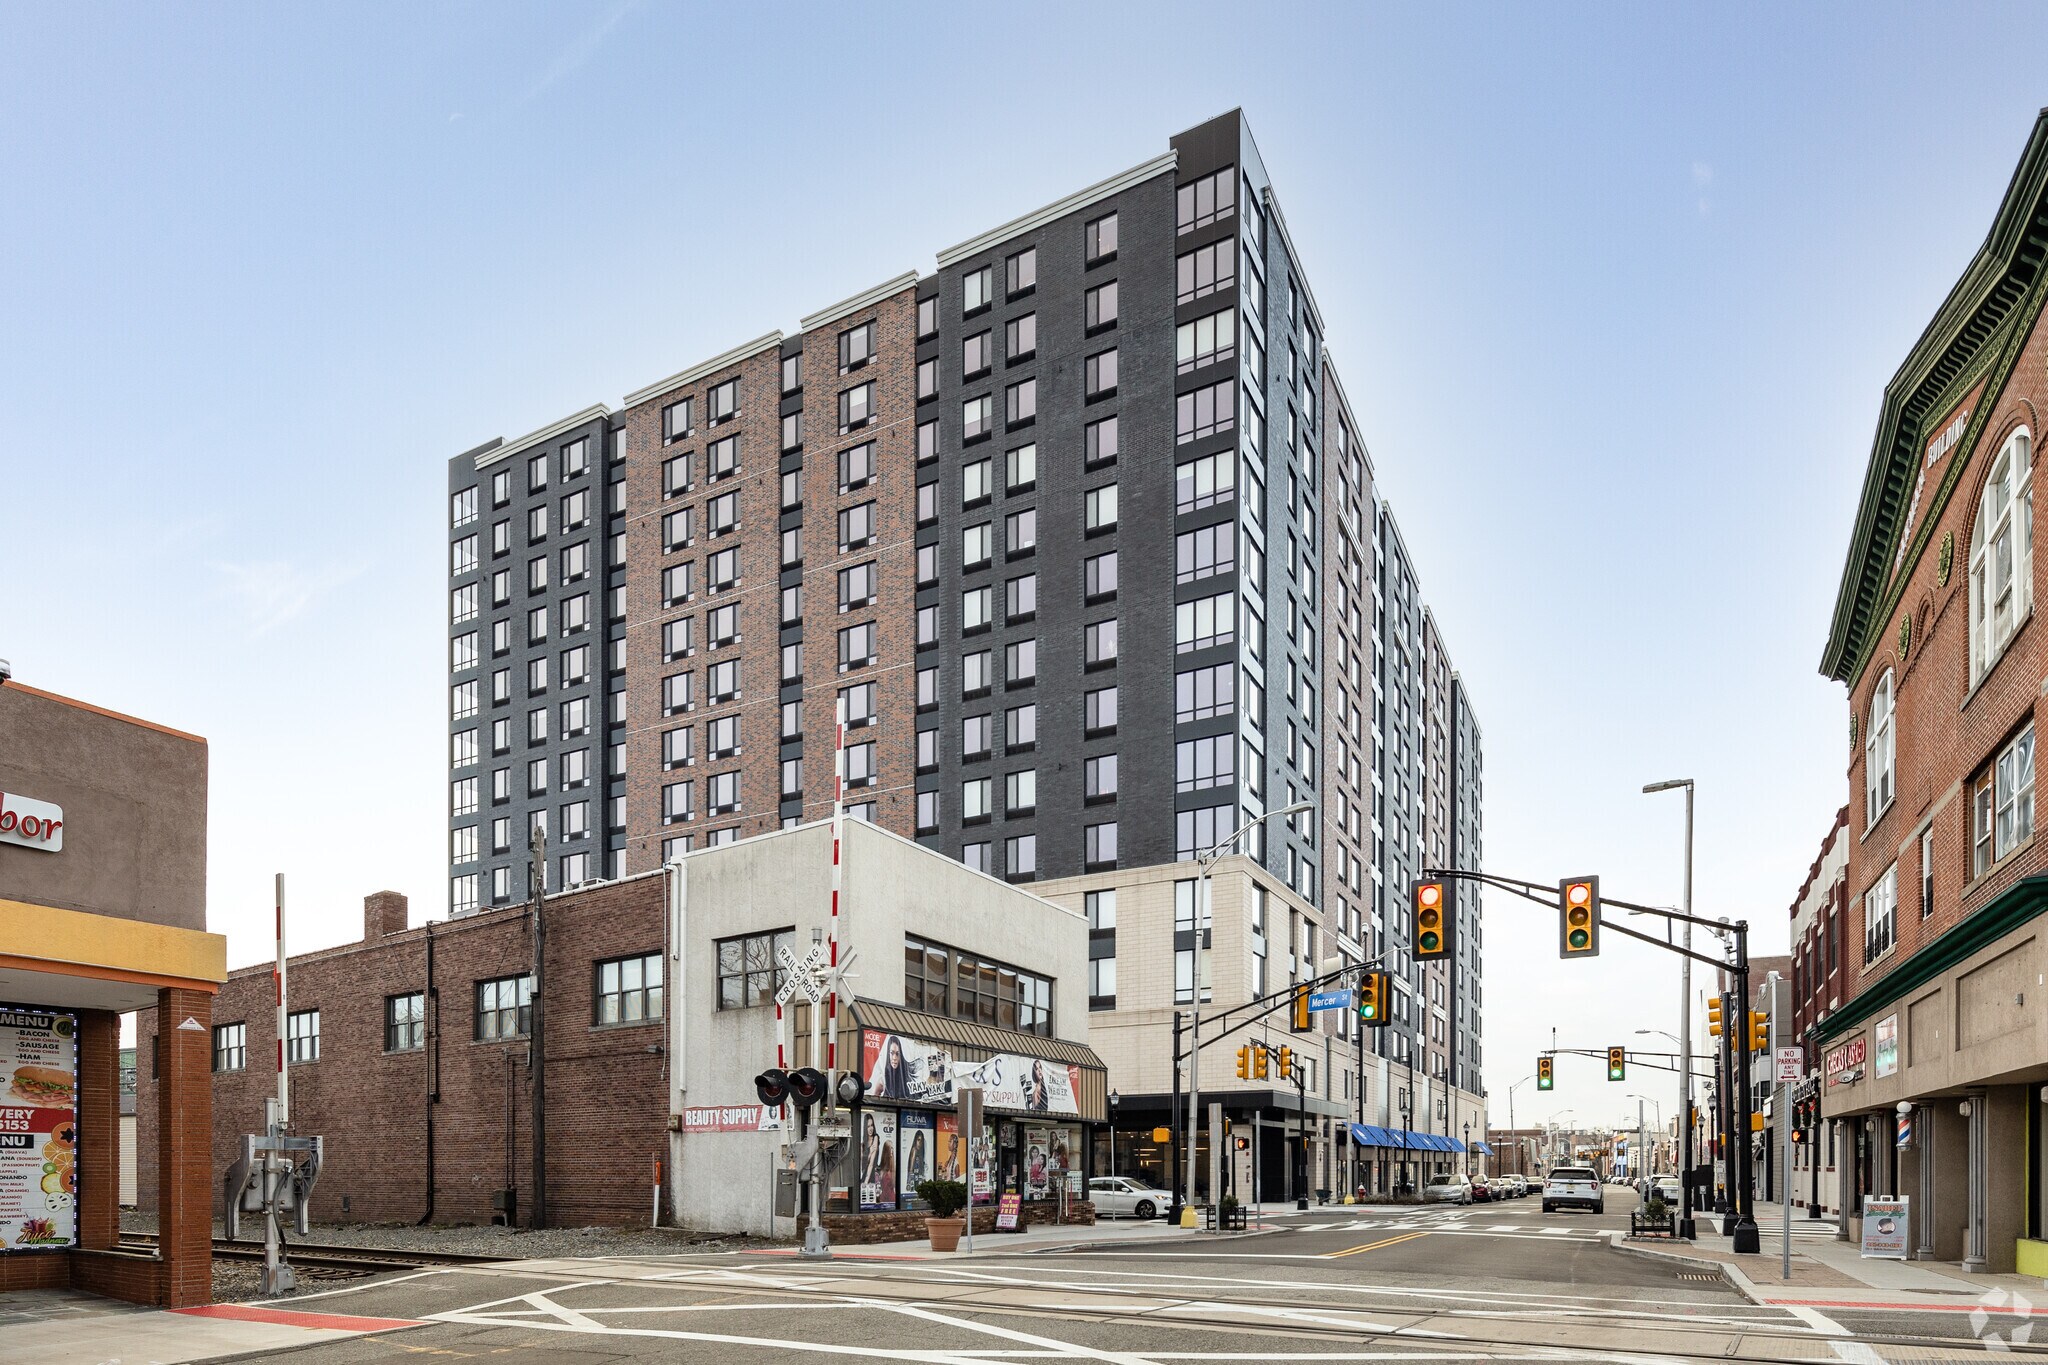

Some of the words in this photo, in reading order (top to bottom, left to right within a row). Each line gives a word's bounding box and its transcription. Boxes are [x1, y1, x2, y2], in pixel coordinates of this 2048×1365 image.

[779, 948, 796, 973] RAIL
[778, 948, 820, 1002] CROSSING
[801, 978, 820, 1003] ROAD
[1311, 997, 1336, 1008] Mercer
[1777, 1057, 1801, 1066] PARKING
[1784, 1050, 1795, 1058] NO
[1845, 1038, 1867, 1069] ASHED
[991, 1090, 1020, 1104] SUPPLY
[685, 1110, 720, 1126] BEAUTY
[722, 1107, 758, 1125] SUPPLY
